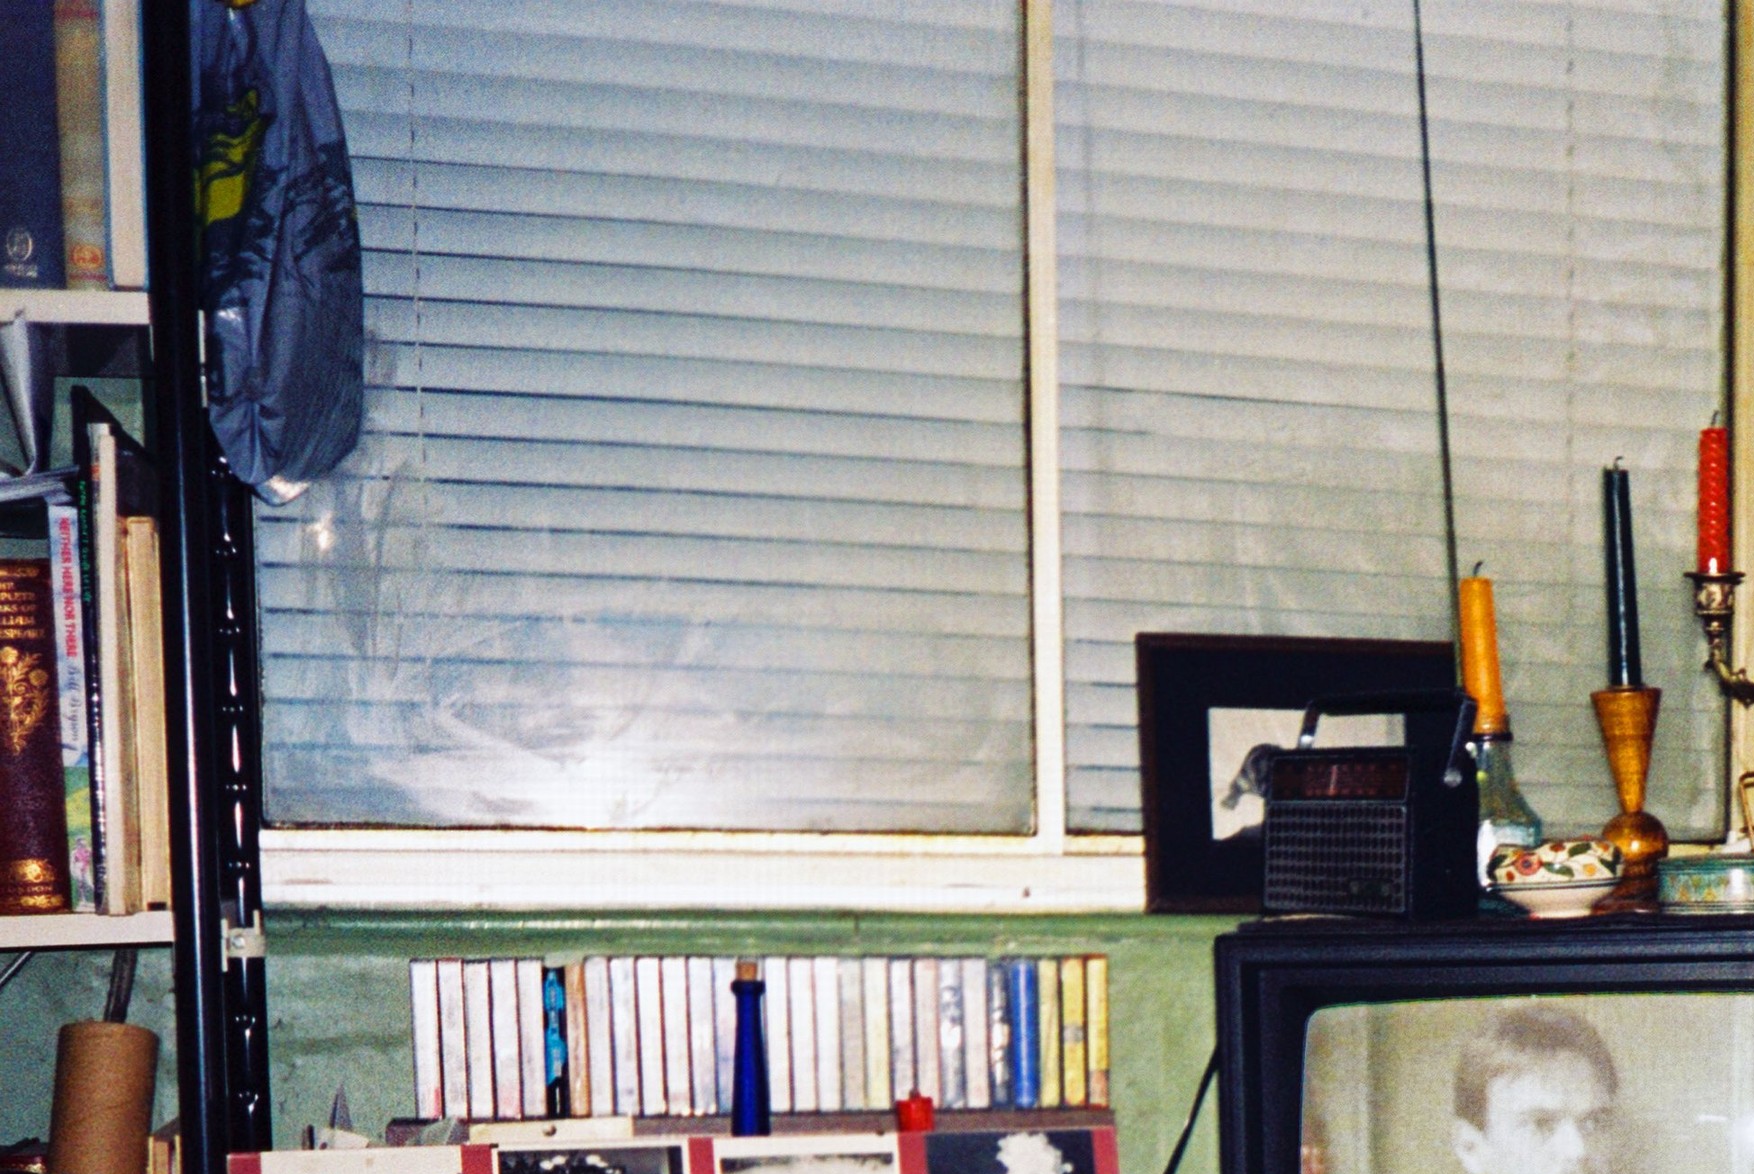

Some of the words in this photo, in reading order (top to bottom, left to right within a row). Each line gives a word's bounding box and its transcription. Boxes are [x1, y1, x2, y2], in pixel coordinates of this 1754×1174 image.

[59, 516, 73, 564] NEITHER
[61, 566, 75, 594] HERE
[62, 597, 76, 621] NOR
[64, 622, 78, 658] THERE
